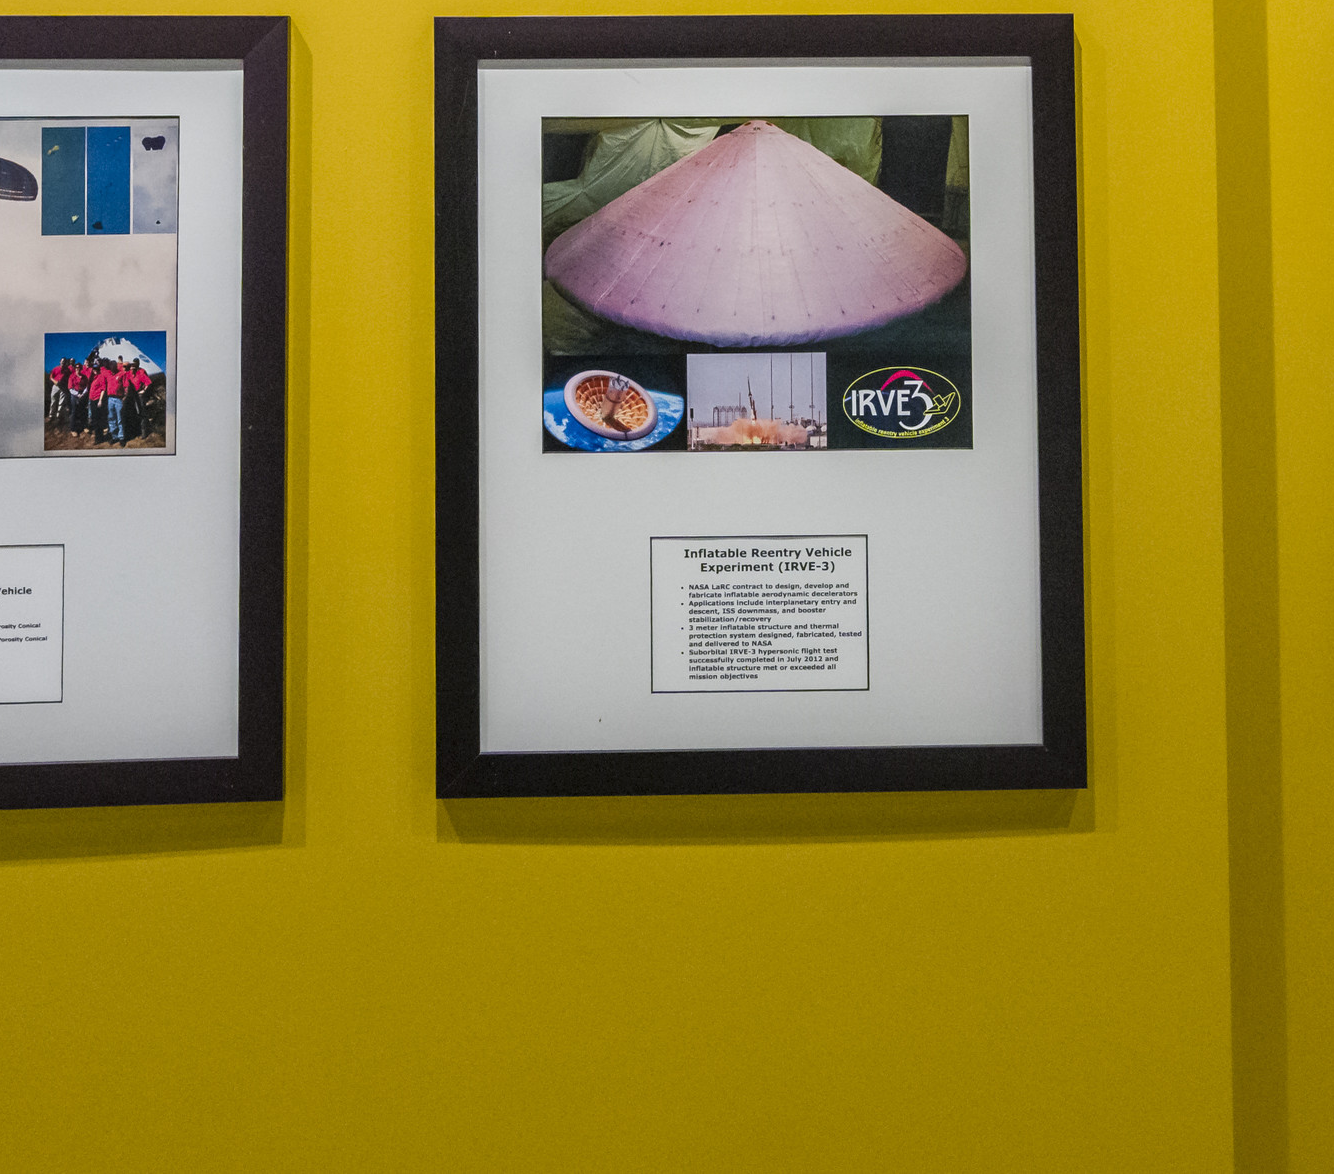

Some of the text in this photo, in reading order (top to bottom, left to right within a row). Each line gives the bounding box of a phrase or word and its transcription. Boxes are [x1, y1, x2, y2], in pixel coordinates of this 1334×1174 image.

[854, 417, 878, 433] inflatable
[684, 547, 852, 559] Inflatable Reentry Vehicle
[700, 560, 835, 574] Experiment (IRVE-3)
[804, 582, 834, 590] develop
